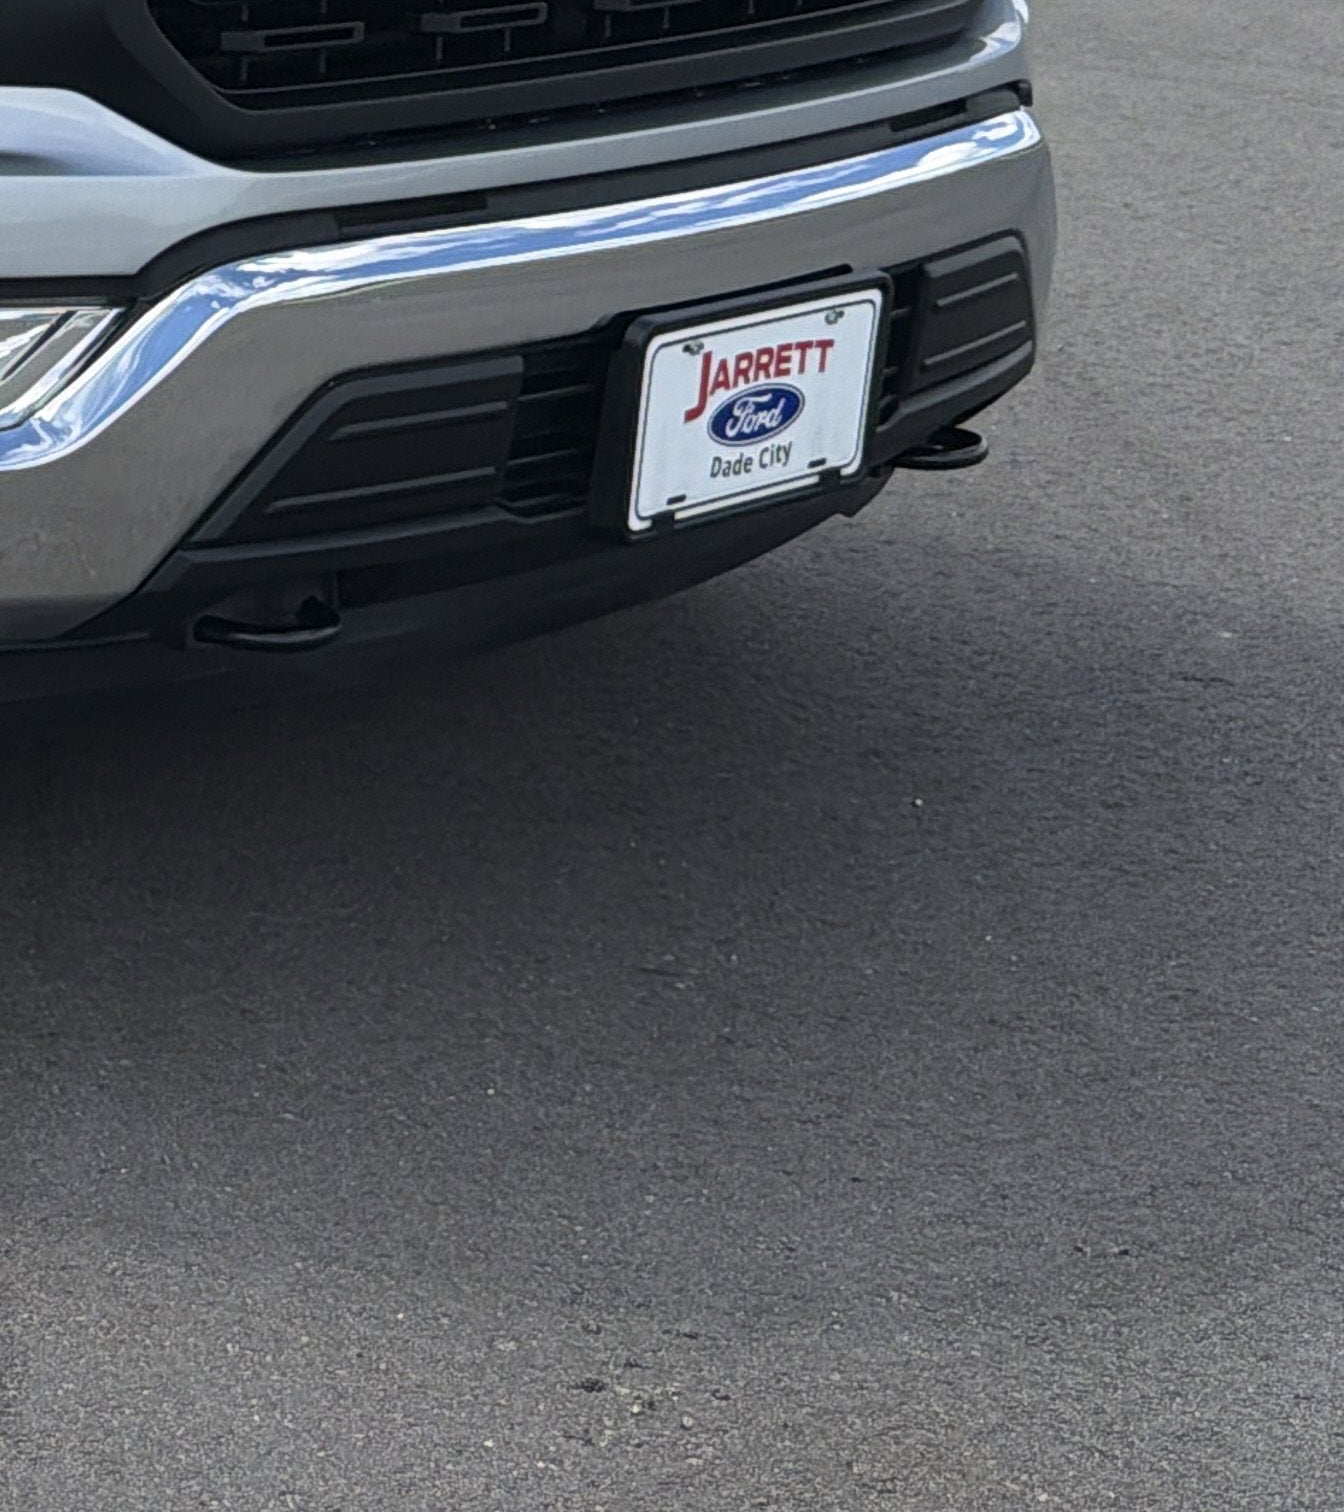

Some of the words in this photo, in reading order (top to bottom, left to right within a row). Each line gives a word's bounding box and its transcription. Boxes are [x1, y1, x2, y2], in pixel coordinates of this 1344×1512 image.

[683, 338, 835, 423] JARRETT
[725, 392, 787, 438] Ford
[710, 453, 754, 479] Dade
[758, 441, 793, 469] City
